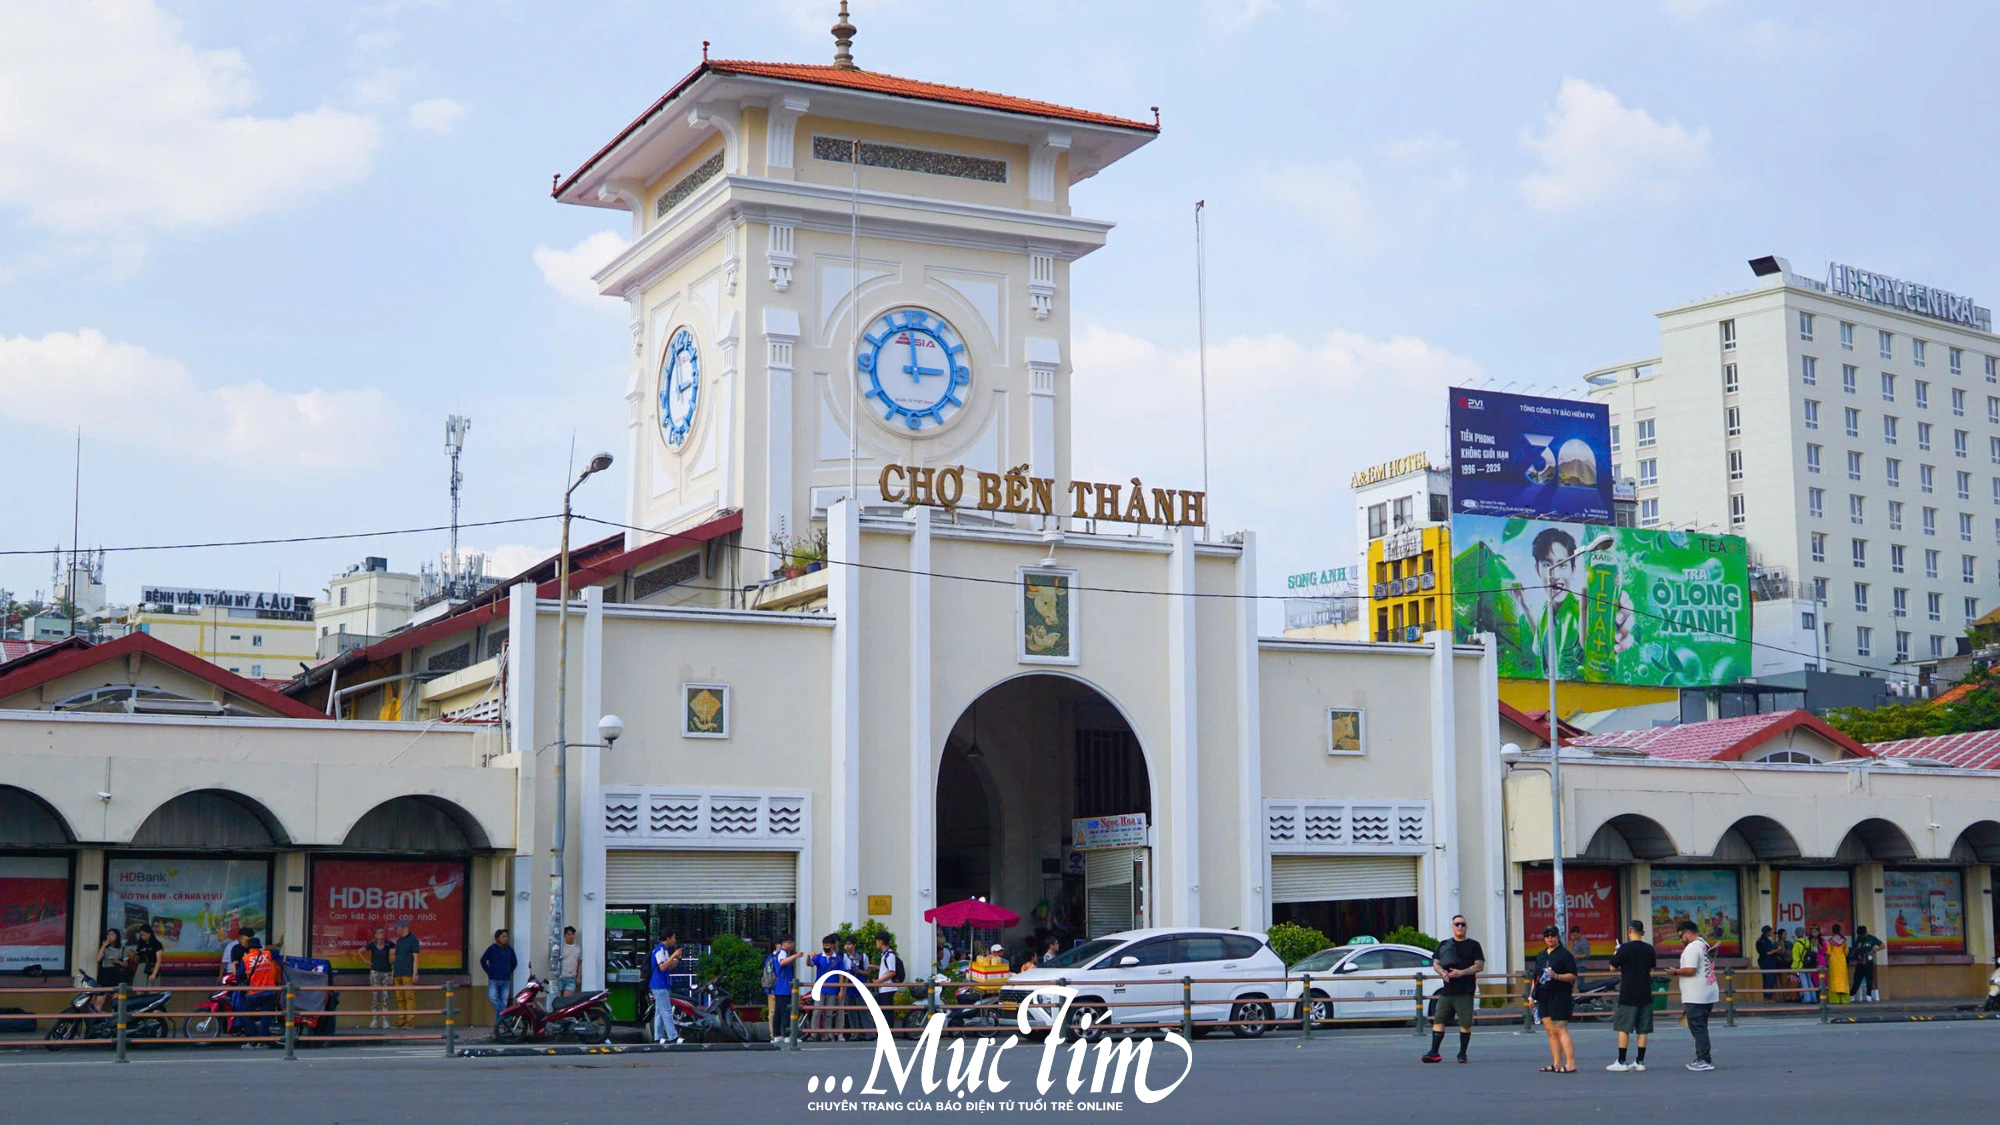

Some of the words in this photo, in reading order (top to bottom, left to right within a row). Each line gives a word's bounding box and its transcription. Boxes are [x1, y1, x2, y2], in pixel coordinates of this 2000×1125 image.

[1830, 261, 1903, 307] LIBERTY
[1901, 280, 1980, 327] CENTRAL
[1474, 433, 1496, 445] PHONG
[1461, 446, 1482, 459] KHÔNG
[1496, 450, 1509, 461] HẠN
[1350, 462, 1388, 489] A&EM
[1388, 451, 1430, 479] HOTEL
[1461, 464, 1475, 475] 1996
[1485, 463, 1501, 473] 2026
[879, 463, 964, 512] CHỢ
[976, 463, 1055, 516] BẾN
[1067, 476, 1206, 527] THÀNH
[1287, 571, 1318, 589] SONG
[1319, 567, 1347, 585] ANH
[145, 588, 174, 604] BỆNH
[177, 590, 201, 606] VIỆN
[204, 590, 233, 607] THẨM
[235, 593, 251, 608] MỸ
[255, 592, 291, 611] Á-ÂU
[1652, 576, 1672, 607] Ô
[1675, 583, 1741, 610] LONG
[1660, 607, 1735, 636] XANH
[120, 871, 166, 883] HDBank
[329, 887, 429, 910] HDBank
[1529, 891, 1595, 909] HDank
